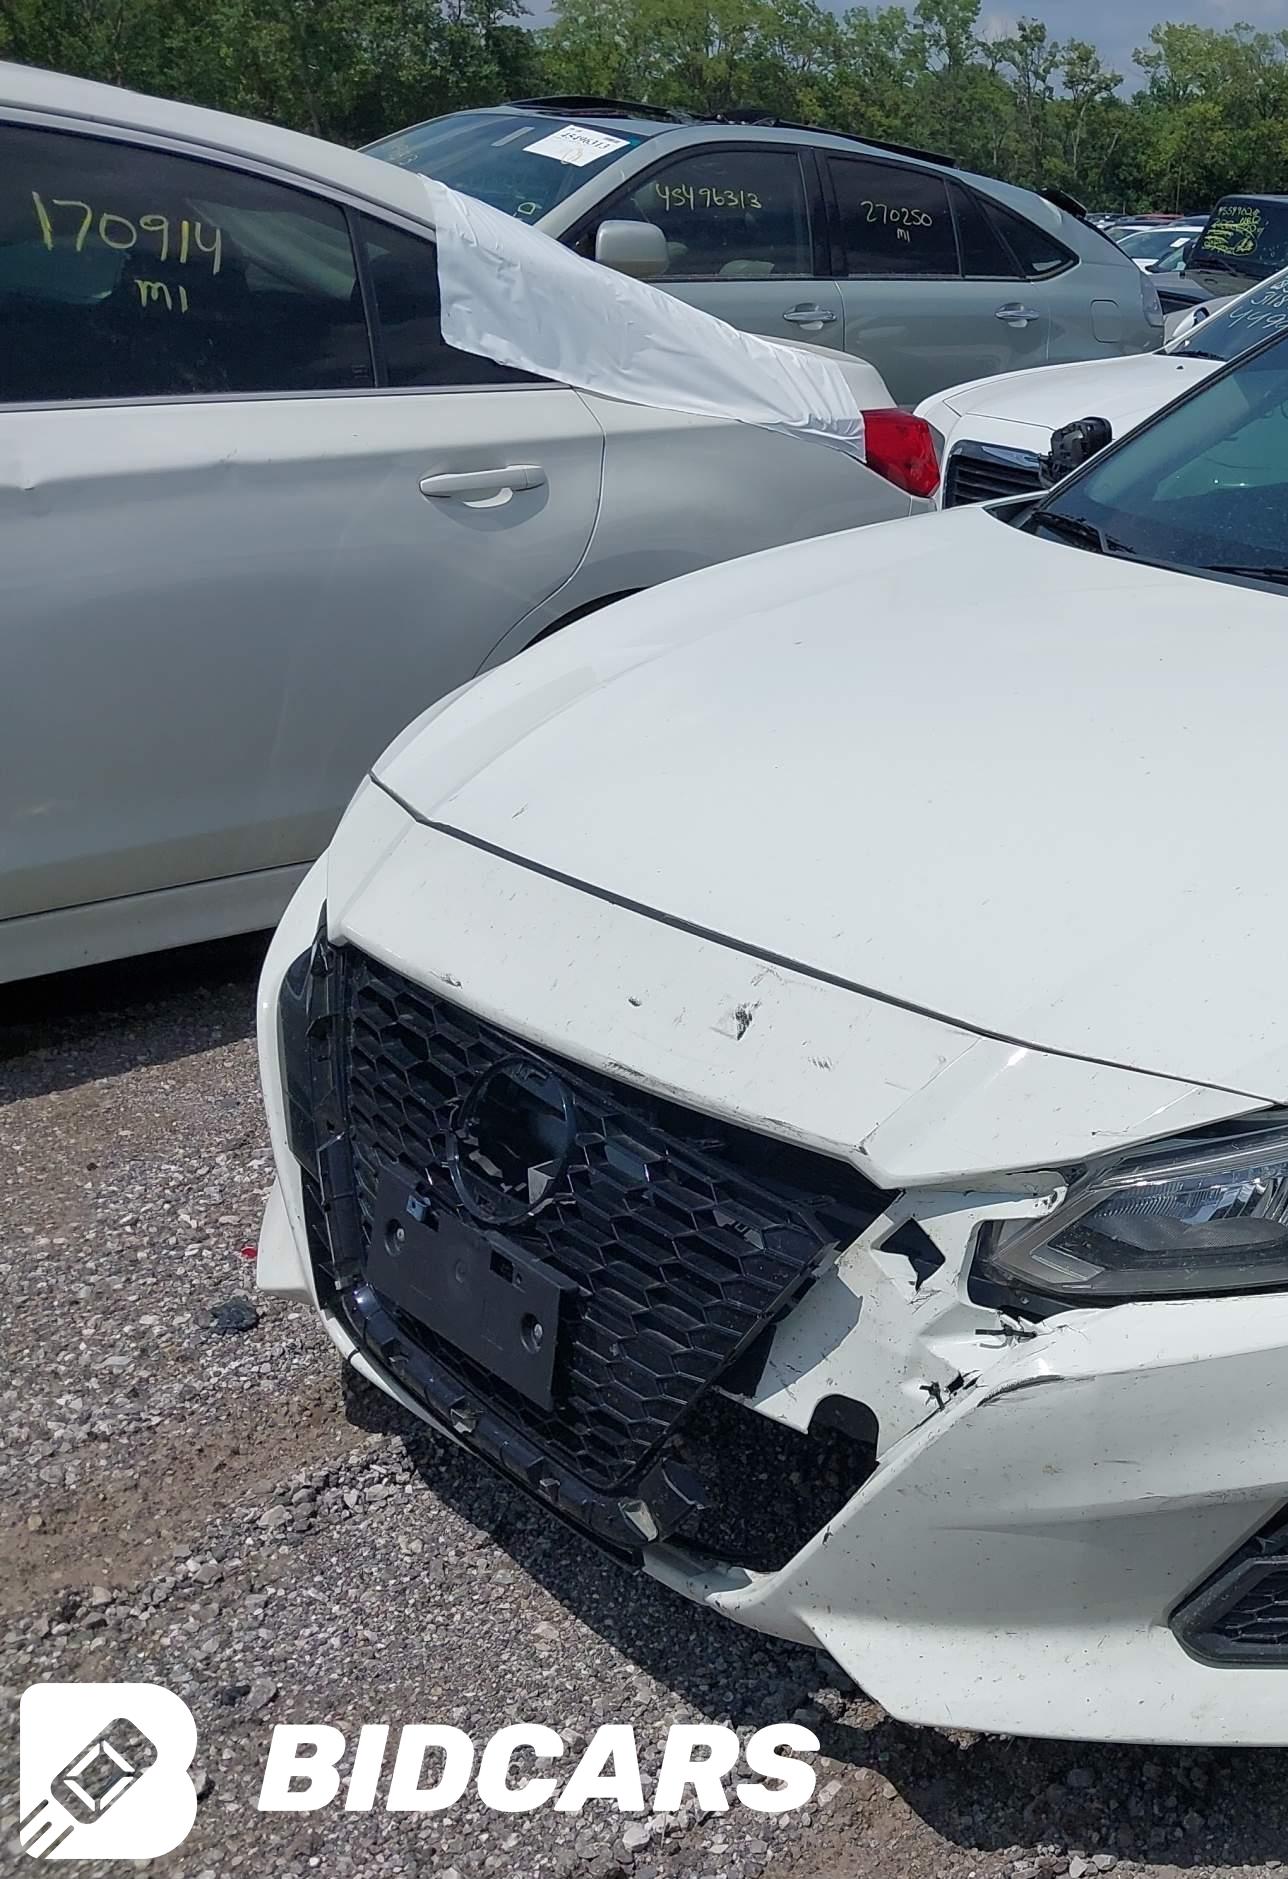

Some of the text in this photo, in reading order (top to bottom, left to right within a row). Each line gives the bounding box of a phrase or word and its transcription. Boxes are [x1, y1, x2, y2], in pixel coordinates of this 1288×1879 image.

[655, 183, 762, 211] 45496313
[861, 201, 933, 227] 270250
[32, 191, 221, 275] 170914
